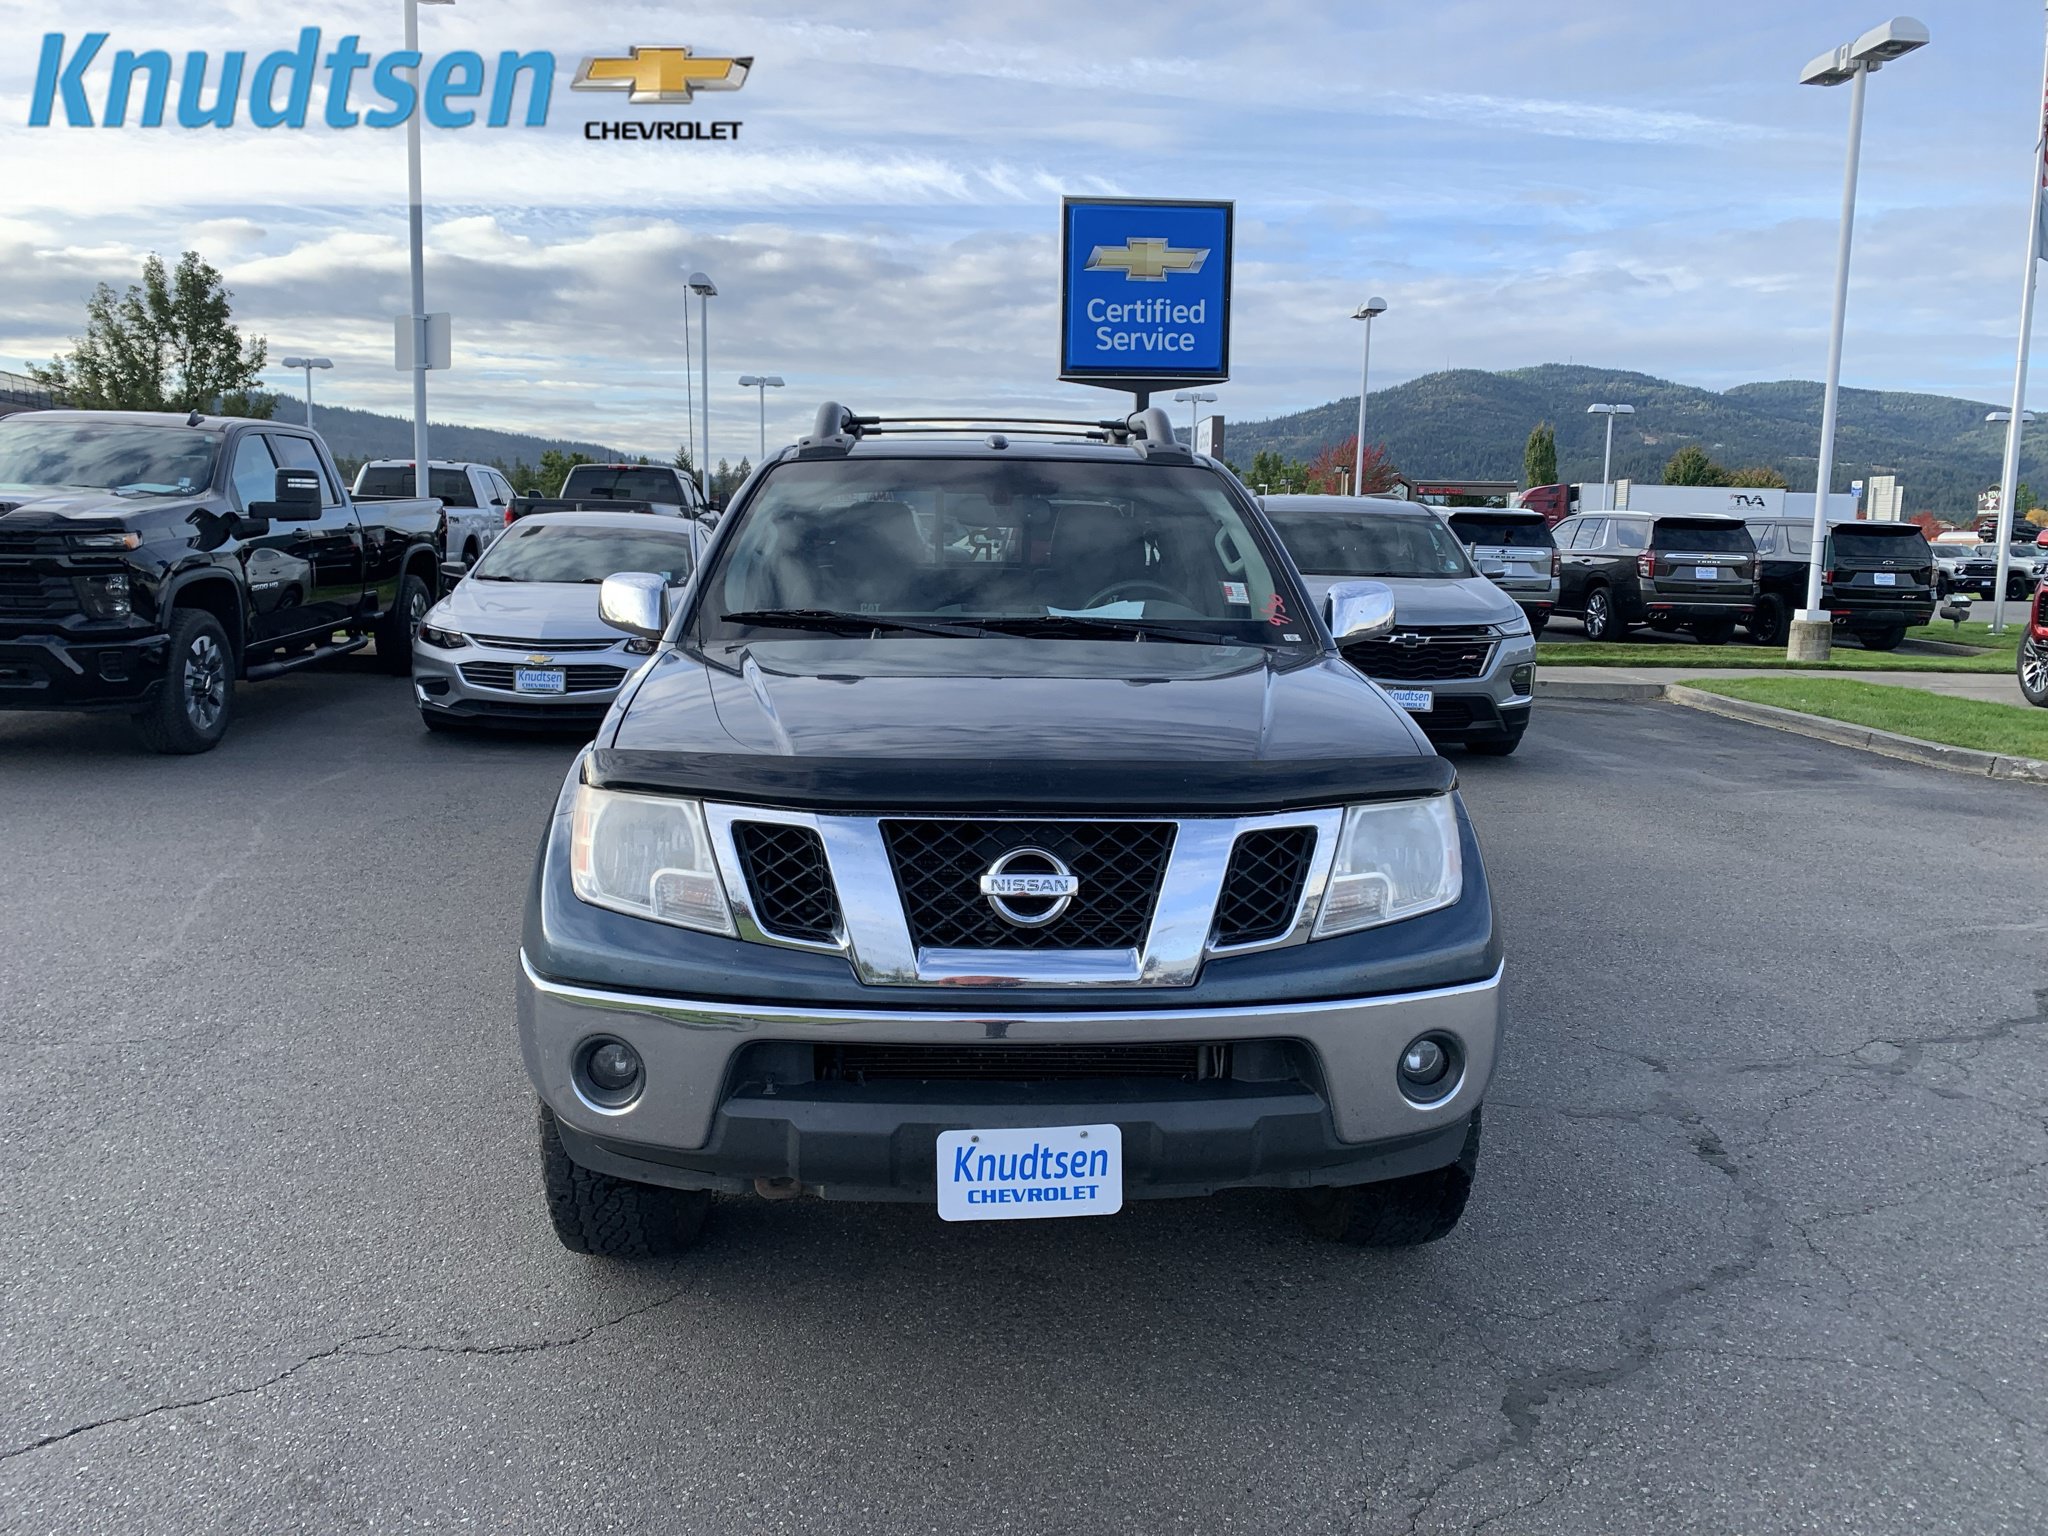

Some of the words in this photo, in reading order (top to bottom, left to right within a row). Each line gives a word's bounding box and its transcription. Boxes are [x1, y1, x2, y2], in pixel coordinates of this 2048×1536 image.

[1086, 298, 1206, 324] Certified
[1095, 327, 1196, 352] Service
[1733, 494, 1766, 507] TVA
[518, 670, 562, 682] Knudtsen
[990, 878, 1069, 893] NISSAN
[953, 1143, 1108, 1182] Knudtsen
[967, 1185, 1099, 1204] CHEVROLET
